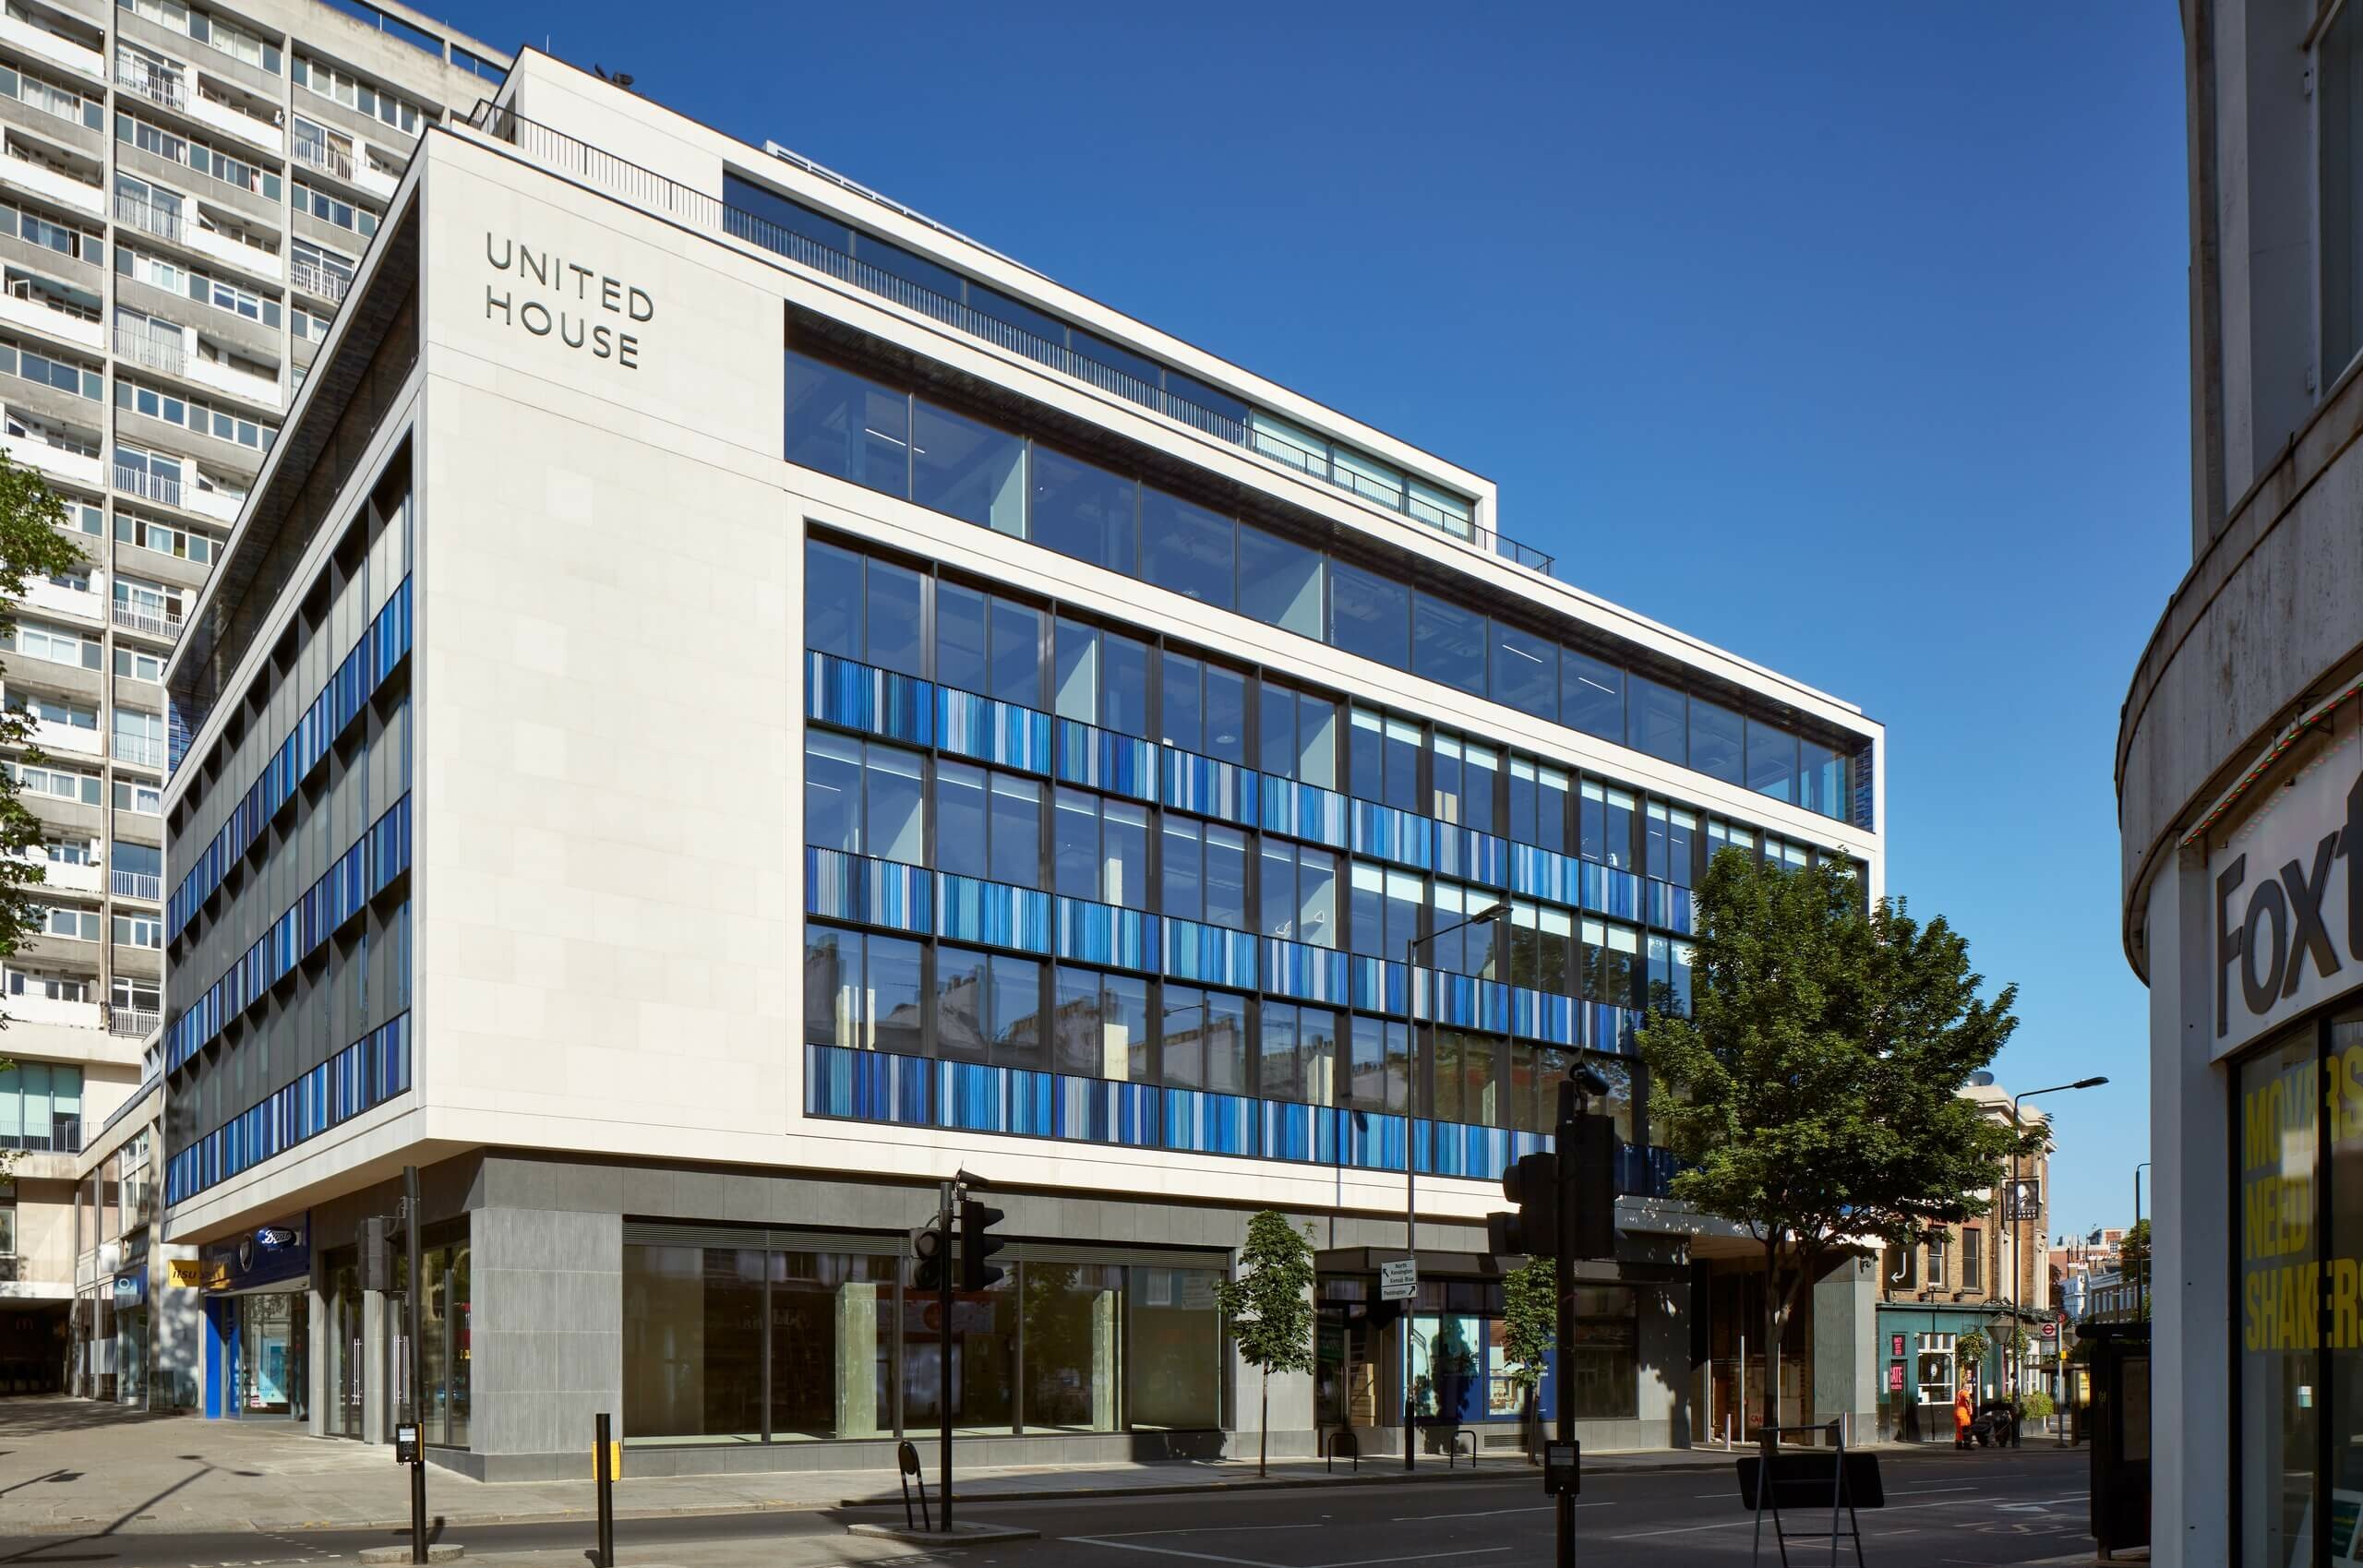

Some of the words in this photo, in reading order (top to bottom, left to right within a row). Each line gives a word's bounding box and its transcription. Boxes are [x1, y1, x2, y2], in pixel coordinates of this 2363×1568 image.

[486, 231, 654, 323] UNITED
[486, 283, 639, 370] HOUSE
[2245, 1174, 2308, 1261] NEED
[173, 1268, 197, 1279] itsu
[2245, 1257, 2363, 1352] SHAKR
